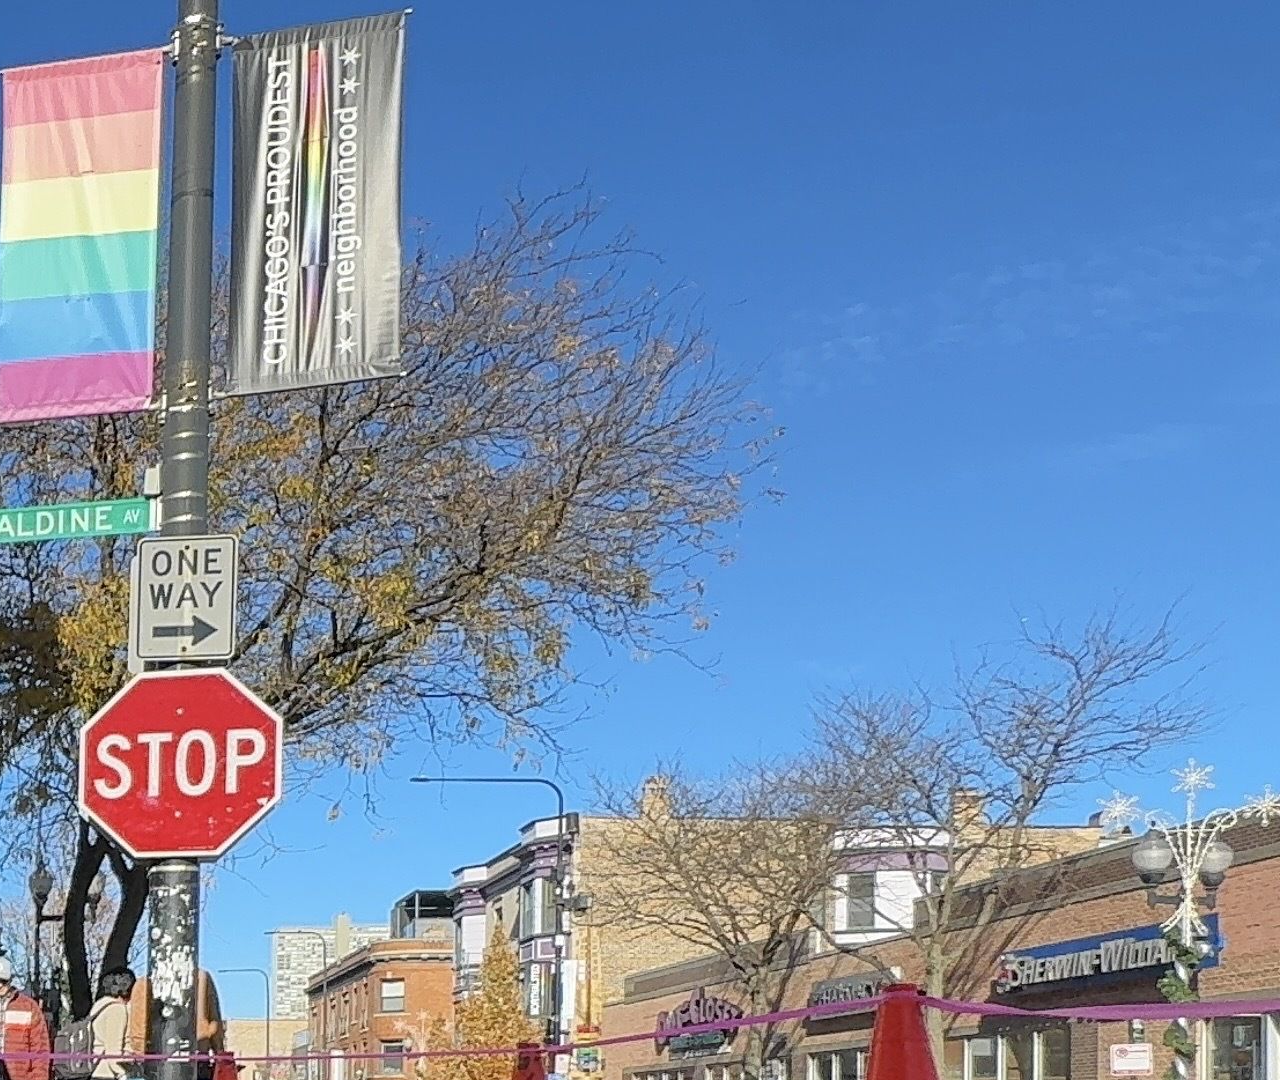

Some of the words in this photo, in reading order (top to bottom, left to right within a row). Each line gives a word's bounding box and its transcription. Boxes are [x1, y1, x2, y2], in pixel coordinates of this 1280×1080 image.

[267, 56, 292, 204] PROUDEST
[334, 106, 362, 294] neighborhood
[263, 210, 290, 365] CHICAGO'S
[123, 508, 141, 524] AV
[149, 581, 223, 610] WAY
[151, 548, 222, 577] ONE
[93, 728, 267, 799] STOP
